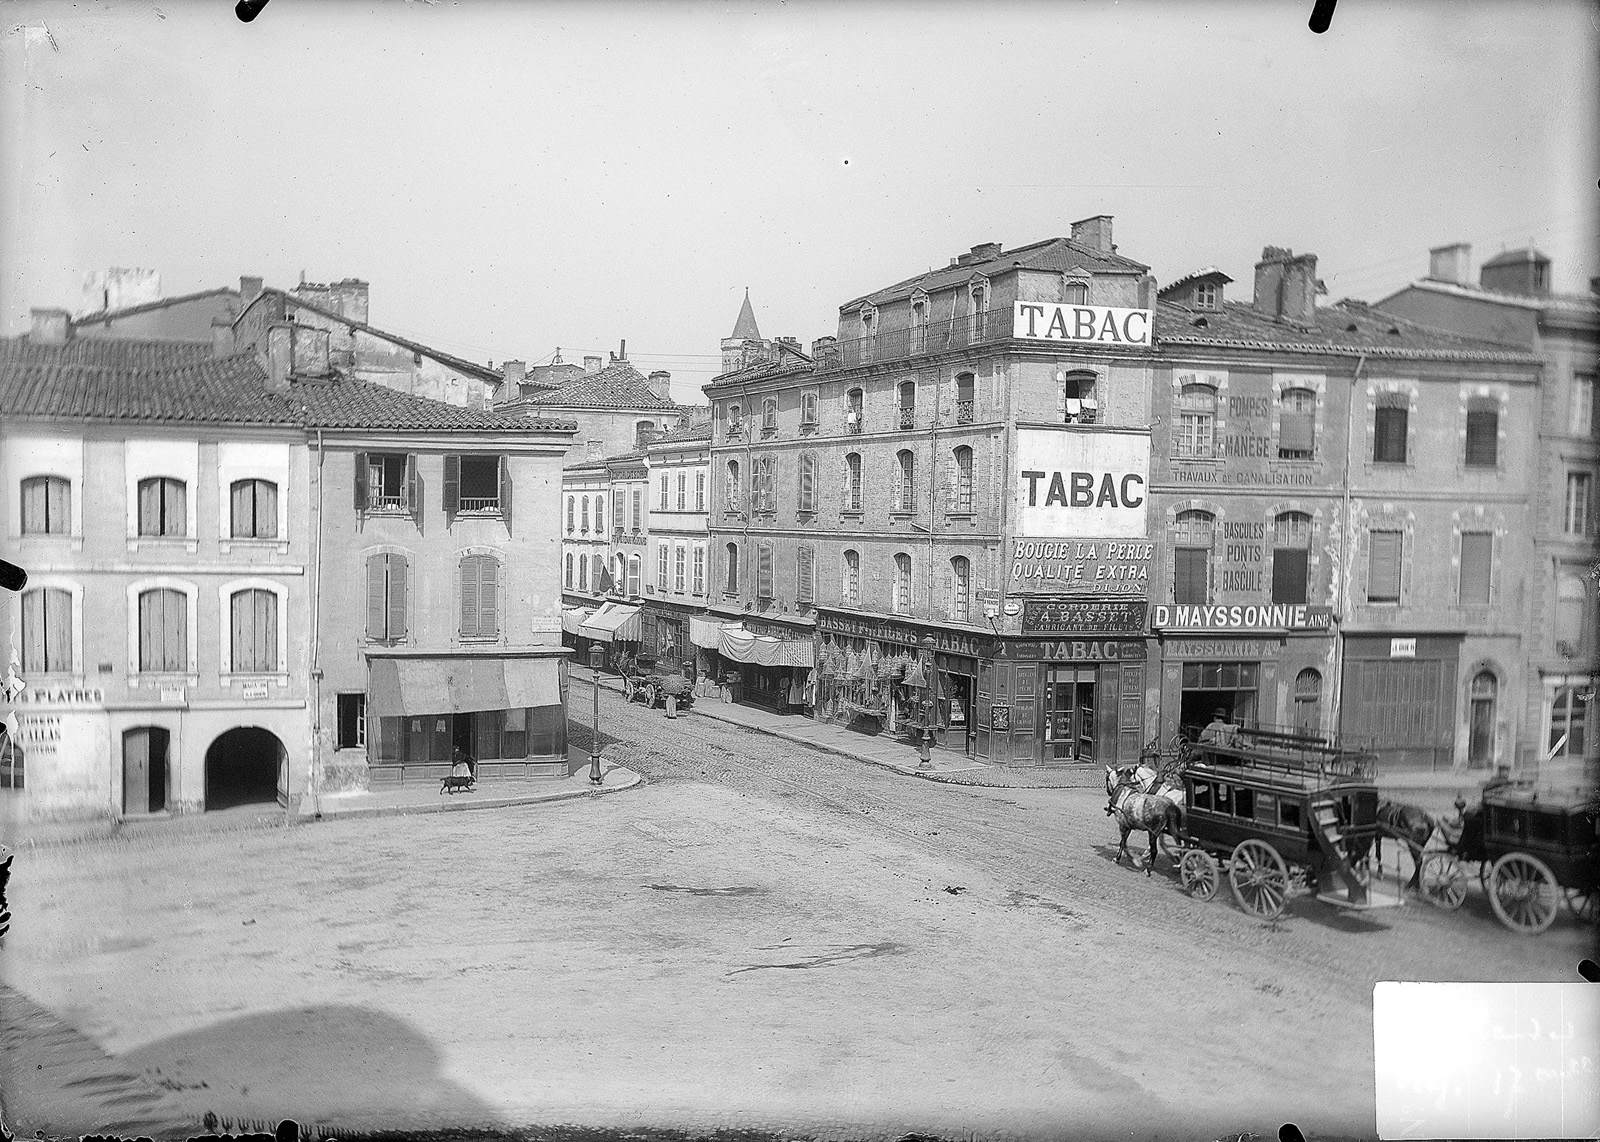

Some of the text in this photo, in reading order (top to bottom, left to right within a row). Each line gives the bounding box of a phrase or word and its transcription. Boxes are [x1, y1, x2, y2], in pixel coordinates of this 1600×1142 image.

[1020, 304, 1147, 343] TABAC
[1229, 396, 1268, 418] POMPES
[1173, 471, 1217, 483] TRAVAUX
[1236, 472, 1312, 485] CANALISATION
[1021, 471, 1144, 509] TABAC
[1224, 522, 1264, 539] BASCULES
[1014, 540, 1154, 560] BOUGIE LA PERLE
[1227, 544, 1261, 562] PONTS
[1012, 560, 1148, 581] QUALITÉ EXTRA
[1093, 583, 1143, 592] DIJON
[1223, 571, 1262, 592] BASCULE
[1046, 603, 1129, 611] CORDERIE
[1059, 611, 1130, 622] BASSET
[1175, 605, 1307, 627] MAYSSONNIE
[933, 631, 979, 656] TABAC
[1041, 641, 1118, 659] TABAC
